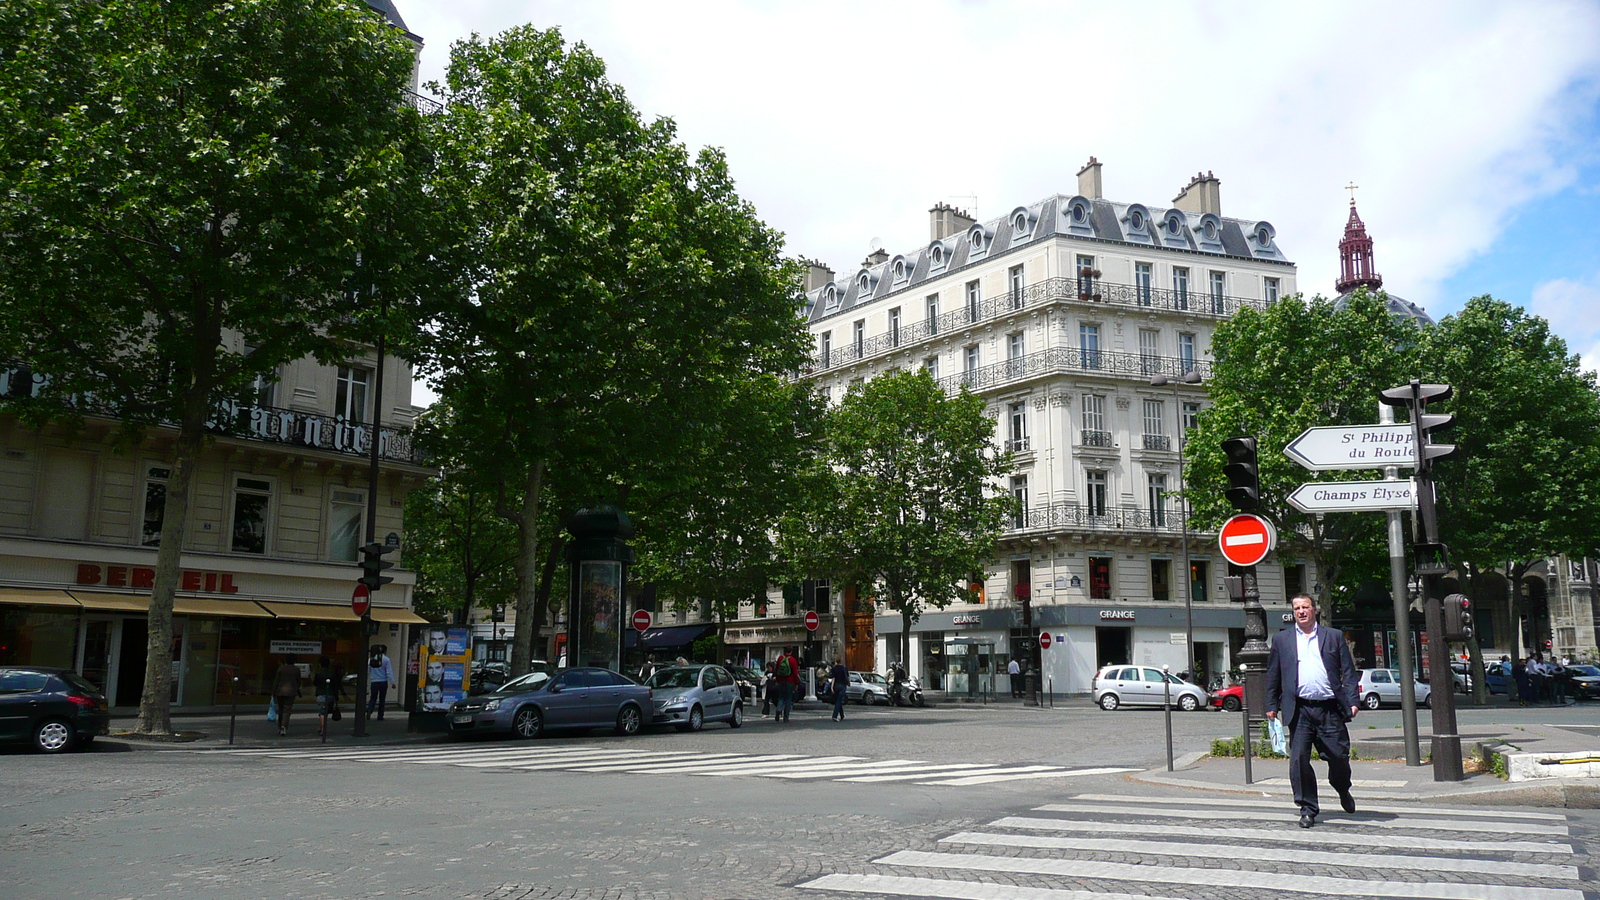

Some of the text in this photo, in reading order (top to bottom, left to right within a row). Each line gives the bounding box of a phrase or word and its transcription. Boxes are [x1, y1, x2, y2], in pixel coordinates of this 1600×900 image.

[1341, 432, 1413, 444] St Philipp
[1349, 448, 1366, 458] du
[1314, 486, 1418, 501] Champs Élysé
[77, 564, 239, 593] BEREIL
[953, 615, 980, 623] GRANGE
[1100, 610, 1135, 618] GRANGE
